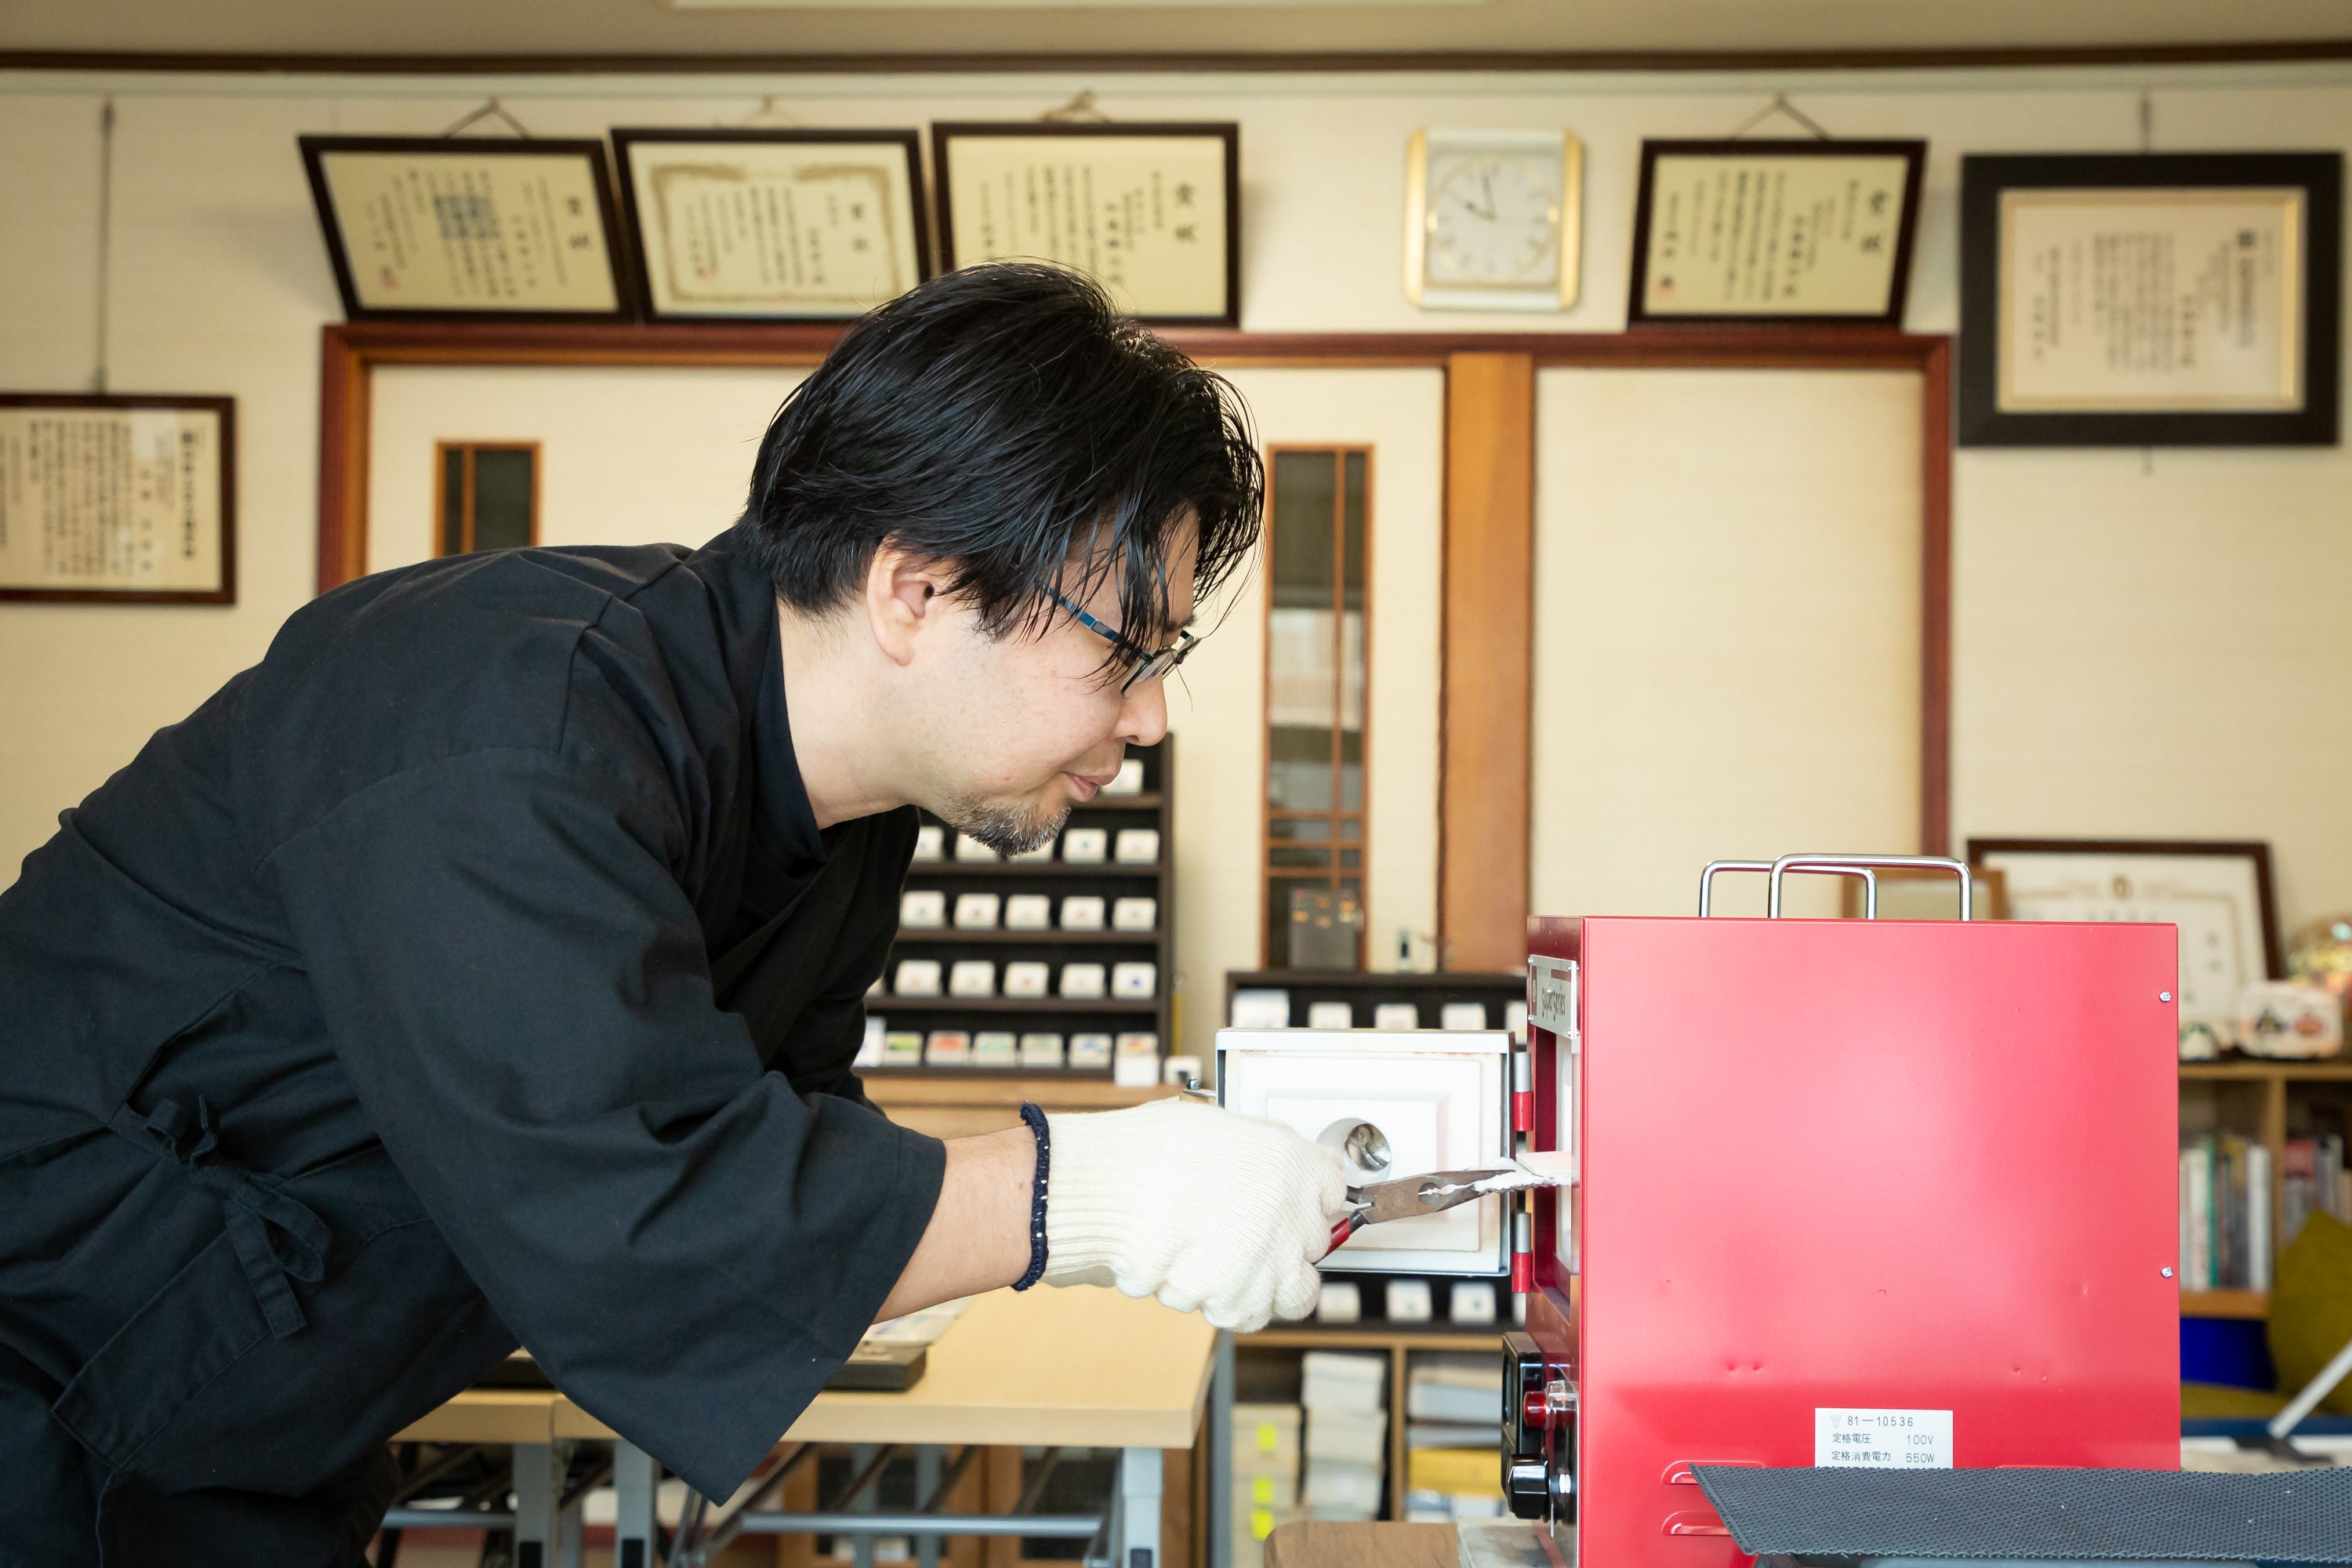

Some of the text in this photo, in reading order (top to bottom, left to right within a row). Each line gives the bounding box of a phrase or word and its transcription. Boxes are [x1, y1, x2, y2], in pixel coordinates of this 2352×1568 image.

[1832, 1433, 1933, 1445] 定格電圧 100V
[1831, 1450, 1935, 1464] 定格消費電力 550W
